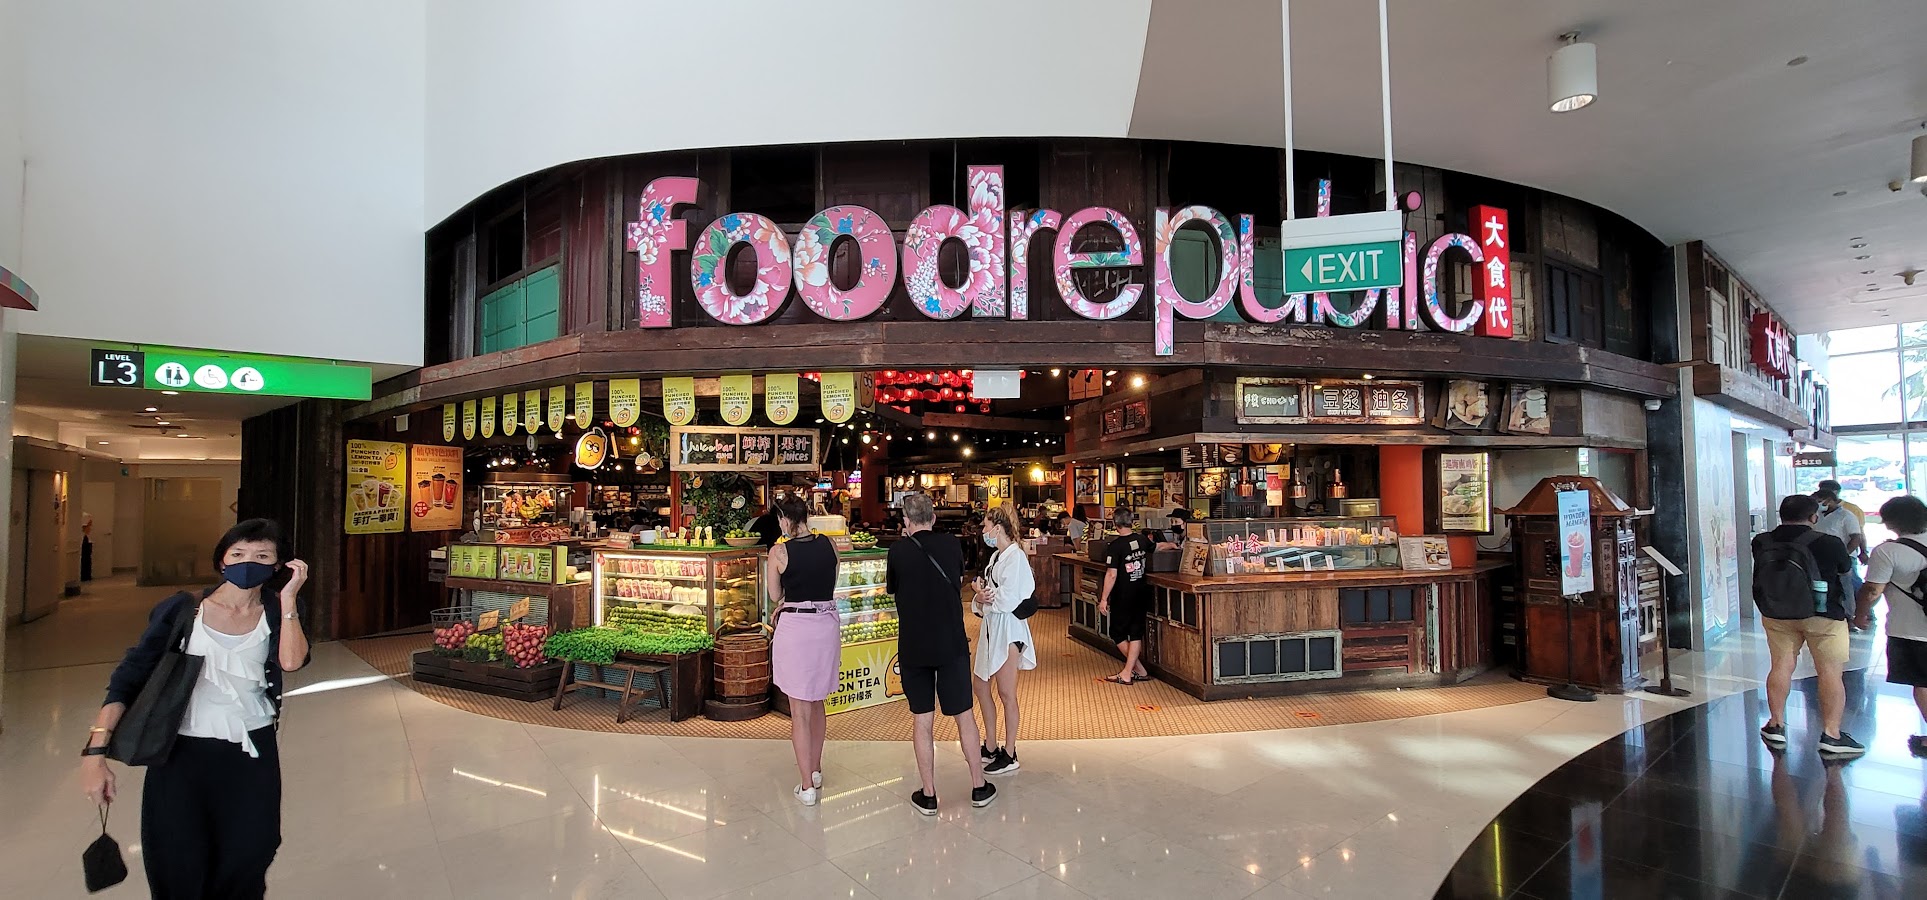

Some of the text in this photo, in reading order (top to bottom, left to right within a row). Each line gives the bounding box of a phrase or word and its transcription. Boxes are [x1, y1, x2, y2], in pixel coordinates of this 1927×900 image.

[1319, 250, 1383, 284] EXIT
[1483, 215, 1508, 330] 大食代
[98, 361, 137, 385] L3
[1323, 389, 1360, 410] 豆浆
[1372, 389, 1410, 411] 油条
[782, 436, 810, 450] 果汁
[1228, 533, 1264, 554] 油条
[839, 667, 870, 680] CHED
[858, 677, 880, 689] TEA
